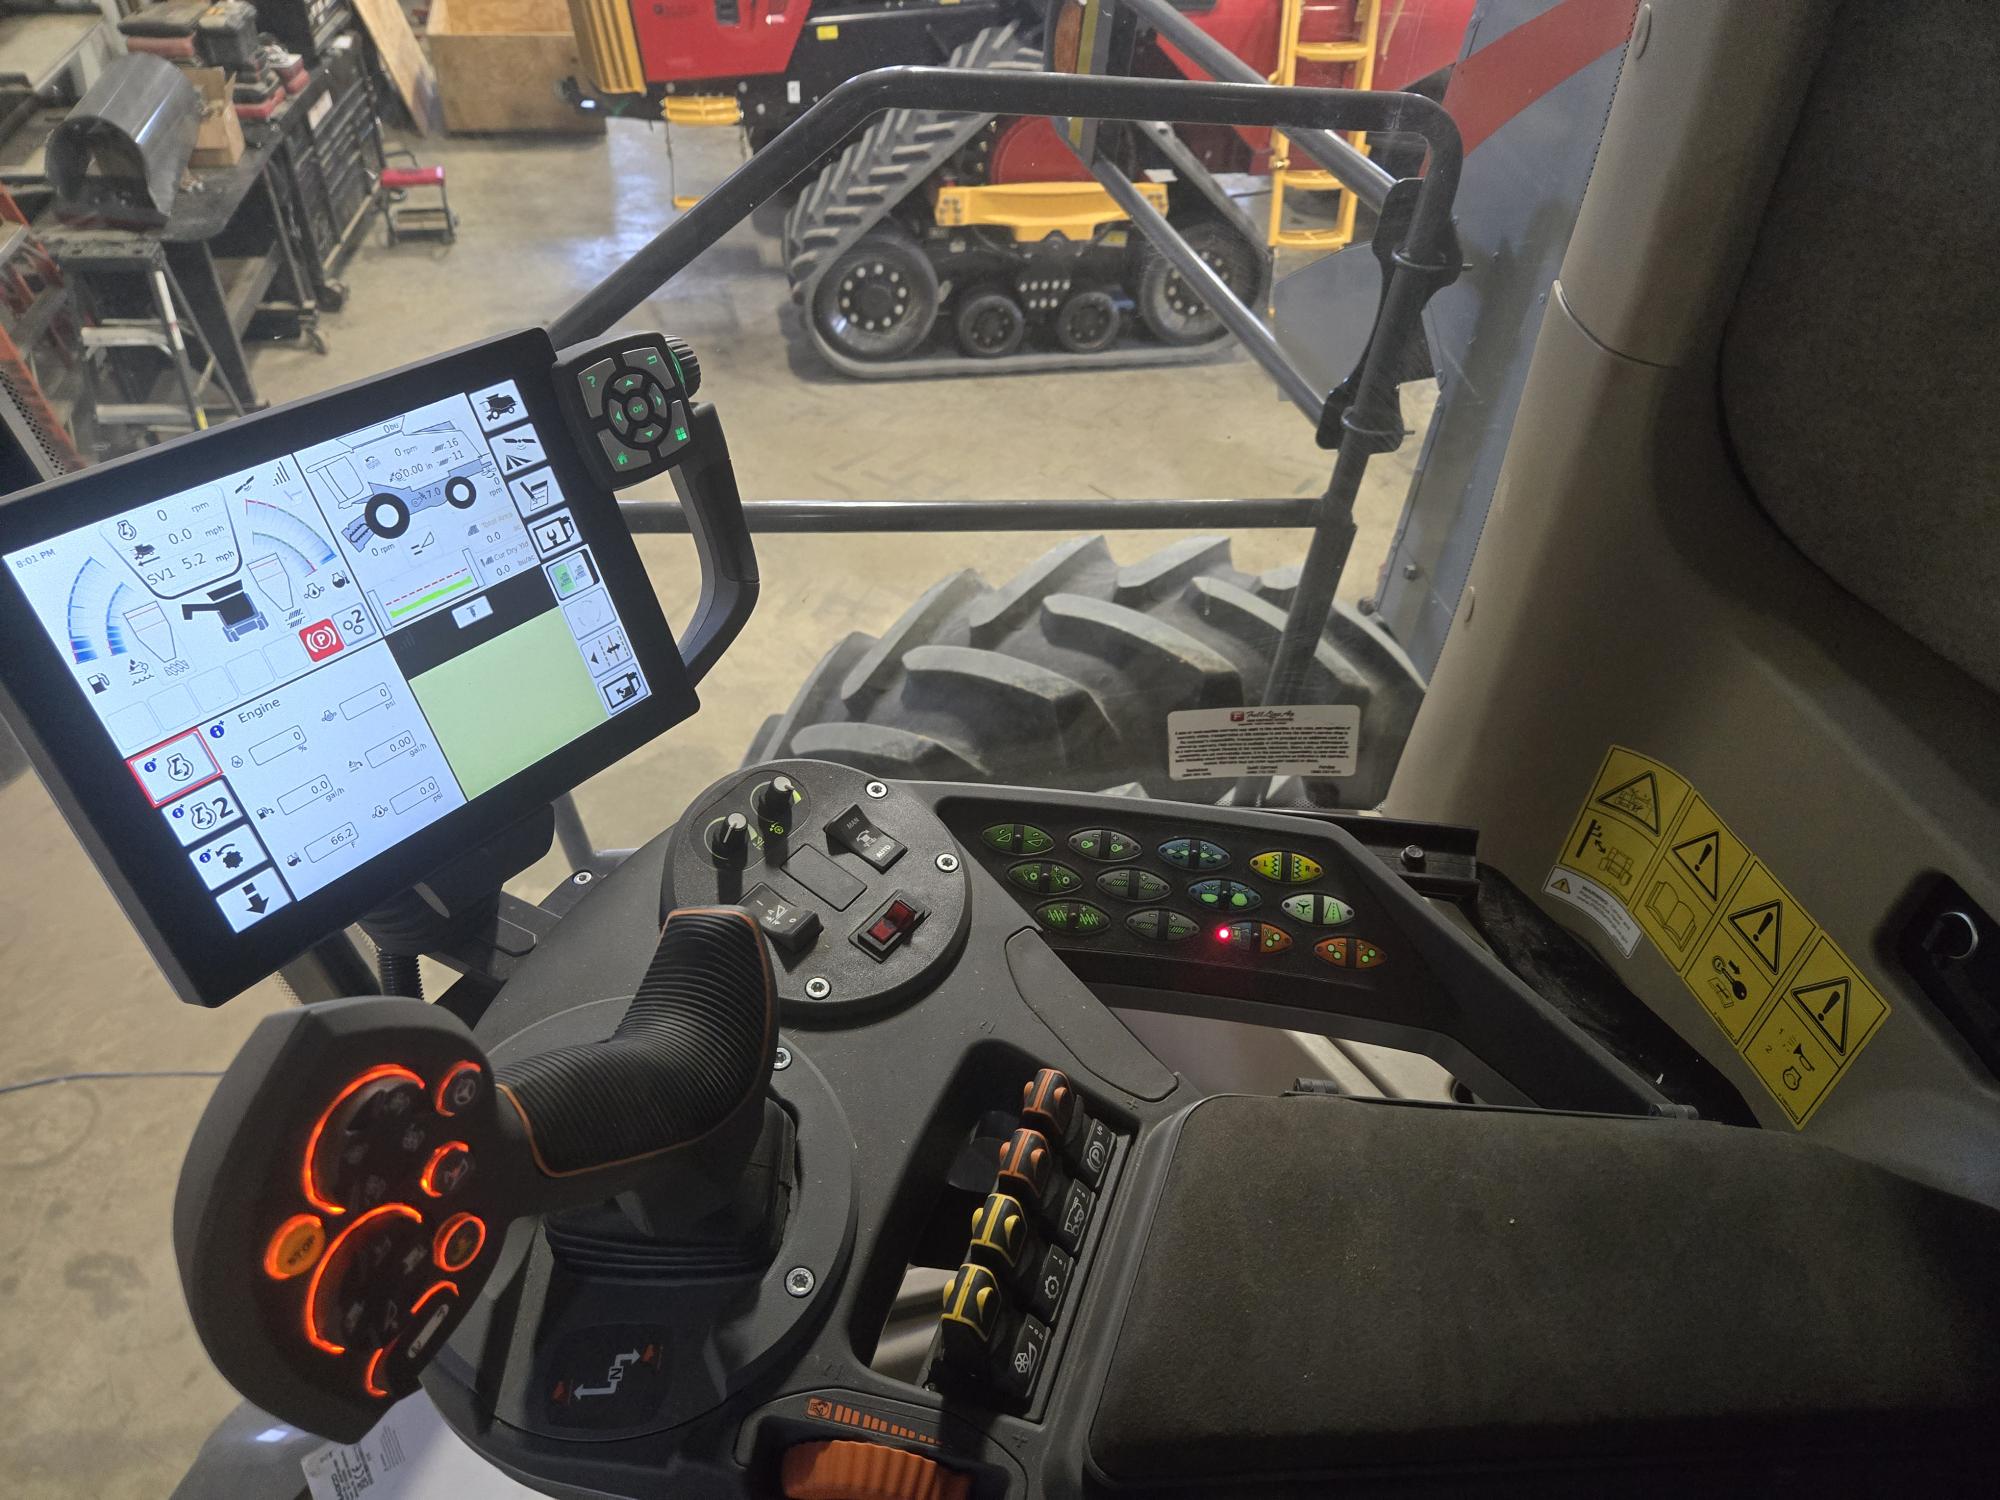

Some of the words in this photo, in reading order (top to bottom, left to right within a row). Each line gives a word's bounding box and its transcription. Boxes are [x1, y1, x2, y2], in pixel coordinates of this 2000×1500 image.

[632, 402, 645, 414] OK
[394, 447, 402, 456] 0
[403, 444, 419, 455] rpm
[402, 463, 425, 477] 0.00
[156, 509, 169, 522] 0
[191, 500, 210, 514] rpm
[167, 527, 193, 545] 0.0
[204, 523, 226, 537] mph
[486, 531, 502, 543] 0.0
[40, 548, 56, 562] PM
[371, 548, 379, 557] 0
[380, 543, 396, 554] rpm
[146, 567, 177, 586] SV1
[181, 552, 207, 570] 5.2
[215, 549, 236, 563] mph
[496, 564, 511, 576] 0.0
[350, 609, 366, 623] 2
[316, 633, 326, 645] P
[379, 688, 388, 697] 0
[239, 699, 281, 723] Engine
[384, 699, 397, 710] psi
[293, 730, 301, 740] 0
[389, 736, 412, 752] 0.00
[409, 741, 427, 757] gal/h
[310, 779, 329, 794] 0.0
[419, 782, 436, 795] 0.0
[325, 786, 345, 802] gal/h
[432, 792, 444, 803] psi
[212, 796, 234, 818] 2
[846, 817, 860, 830] MAN
[330, 827, 354, 846] 66.2
[876, 844, 892, 858] AUTO
[287, 1234, 317, 1266] STOP
[609, 1367, 623, 1380] N
